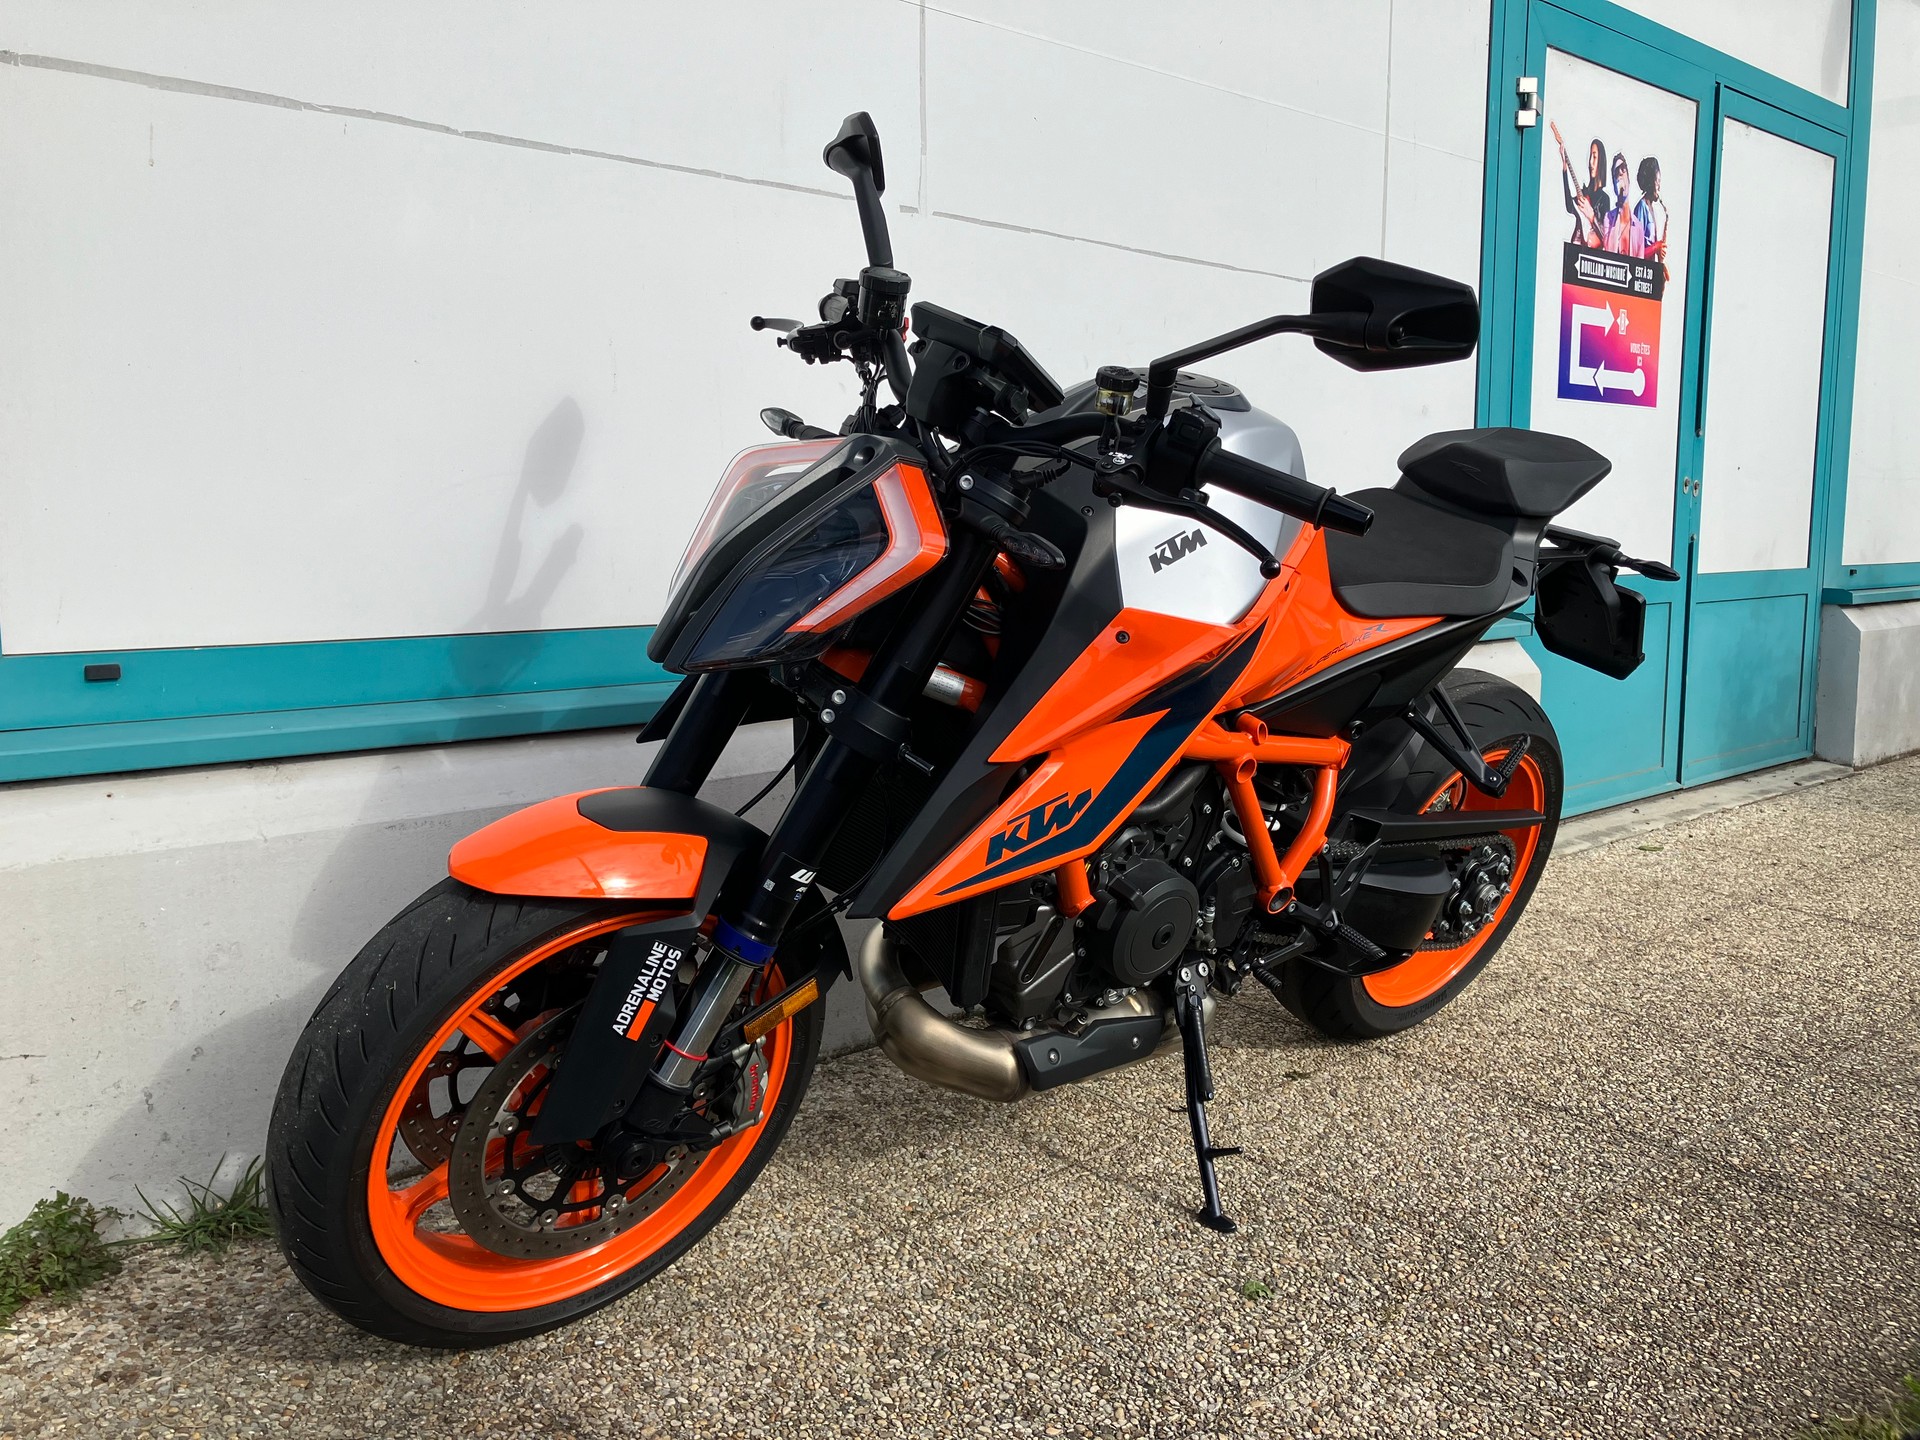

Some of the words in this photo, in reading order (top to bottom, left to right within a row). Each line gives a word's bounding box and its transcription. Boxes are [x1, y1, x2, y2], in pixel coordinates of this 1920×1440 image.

[1635, 266, 1643, 277] EST
[1647, 268, 1653, 280] 30
[1148, 528, 1208, 574] KTM
[985, 788, 1092, 867] KTM
[612, 941, 668, 1036] ADRENALINE
[646, 948, 682, 1002] MOTOS
